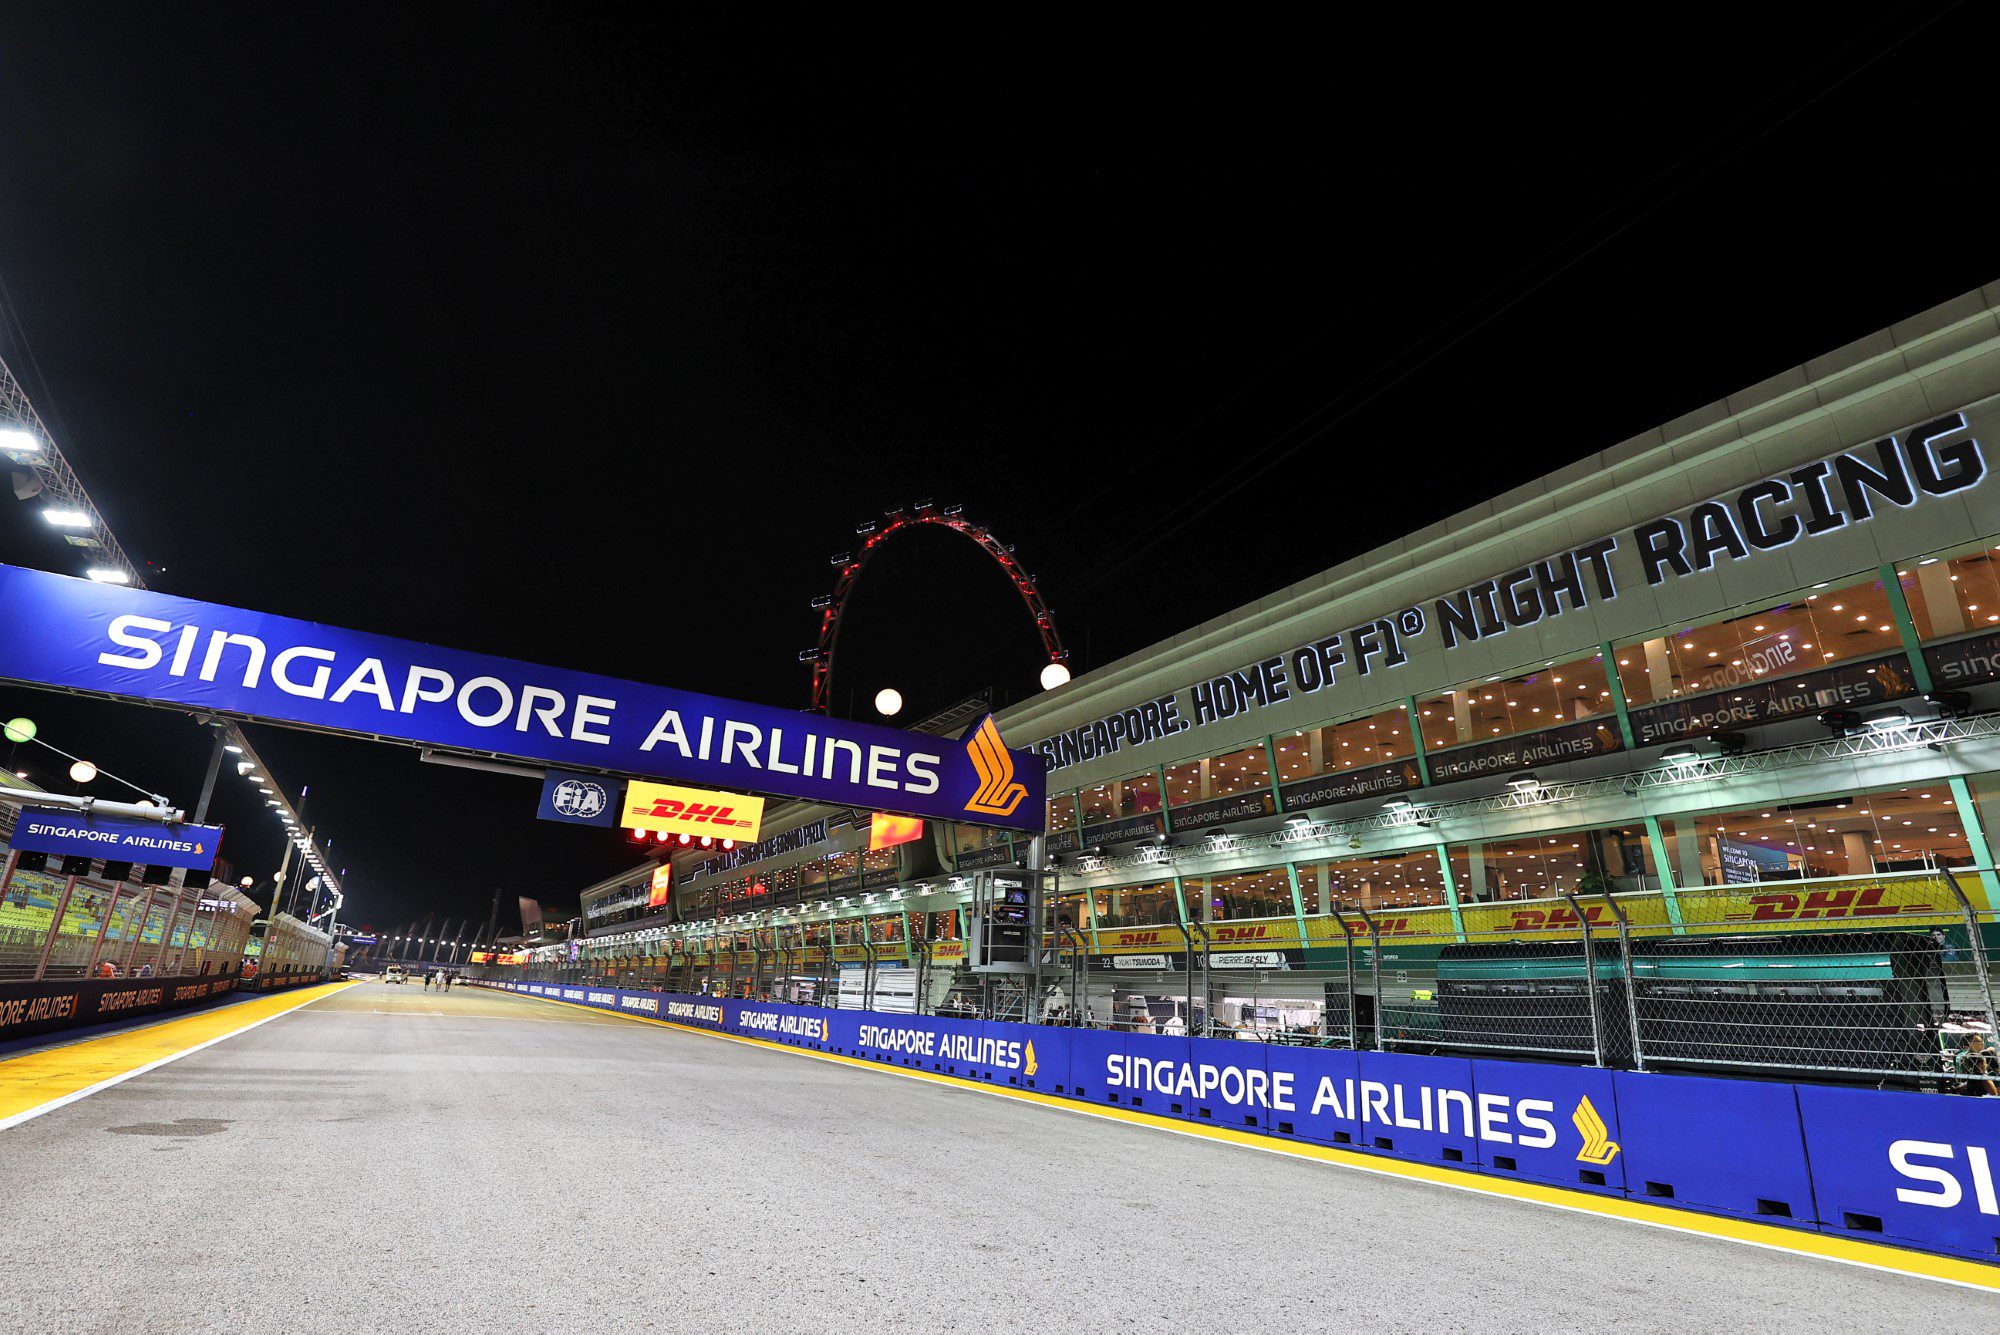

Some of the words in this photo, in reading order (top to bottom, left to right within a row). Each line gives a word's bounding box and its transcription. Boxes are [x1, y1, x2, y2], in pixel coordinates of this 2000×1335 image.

[1040, 695, 1190, 774] SINGAPORE.
[1191, 656, 1290, 726] HOME
[1292, 636, 1347, 694] OF
[1434, 538, 1618, 650] NIGHT
[1633, 412, 1988, 585] RACING
[98, 613, 617, 746] SINGAPORE
[638, 709, 941, 794] AIRLINES
[1641, 702, 1762, 739] SINGAPORE
[1766, 682, 1872, 716] AIRLINES
[1435, 752, 1517, 778] SINGAPORE
[1521, 736, 1594, 764] AIRLINES
[1286, 786, 1348, 807] SINGAPORE
[1349, 775, 1402, 796] AIRLINES
[648, 799, 737, 826] DHL
[1173, 811, 1220, 829] SINGAPORE
[1222, 801, 1262, 819] AIRLINES
[27, 823, 118, 844] SINGAPORE
[122, 835, 193, 852] AIRLINES
[1086, 830, 1123, 844] SINGAPORE
[1125, 824, 1155, 839] AIRLINES
[1724, 854, 1757, 868] SINGAPORE
[1750, 887, 1900, 921] DHL
[1511, 906, 1615, 932] DHL
[1119, 932, 1163, 946] DHL
[1216, 926, 1272, 944] DHL
[1102, 957, 1111, 968] 22
[1131, 957, 1161, 967] TSUNODA
[1218, 956, 1244, 965] PIERRE
[1244, 955, 1269, 965] GASLY
[25, 995, 74, 1022] AIRLINES
[98, 988, 135, 1013] SINGAPORE
[135, 987, 161, 1006] AIRLINES
[668, 1001, 694, 1018] SINGAPORE
[694, 1005, 719, 1022] AIRLINES
[739, 1010, 778, 1032] SINGAPORE
[778, 1014, 821, 1038] AIRLINES
[858, 1023, 936, 1057] SINGAPORE
[938, 1033, 1021, 1069] AIRLINES
[1106, 1053, 1296, 1112] SINGAPORE
[1310, 1076, 1558, 1149] AIRLINES
